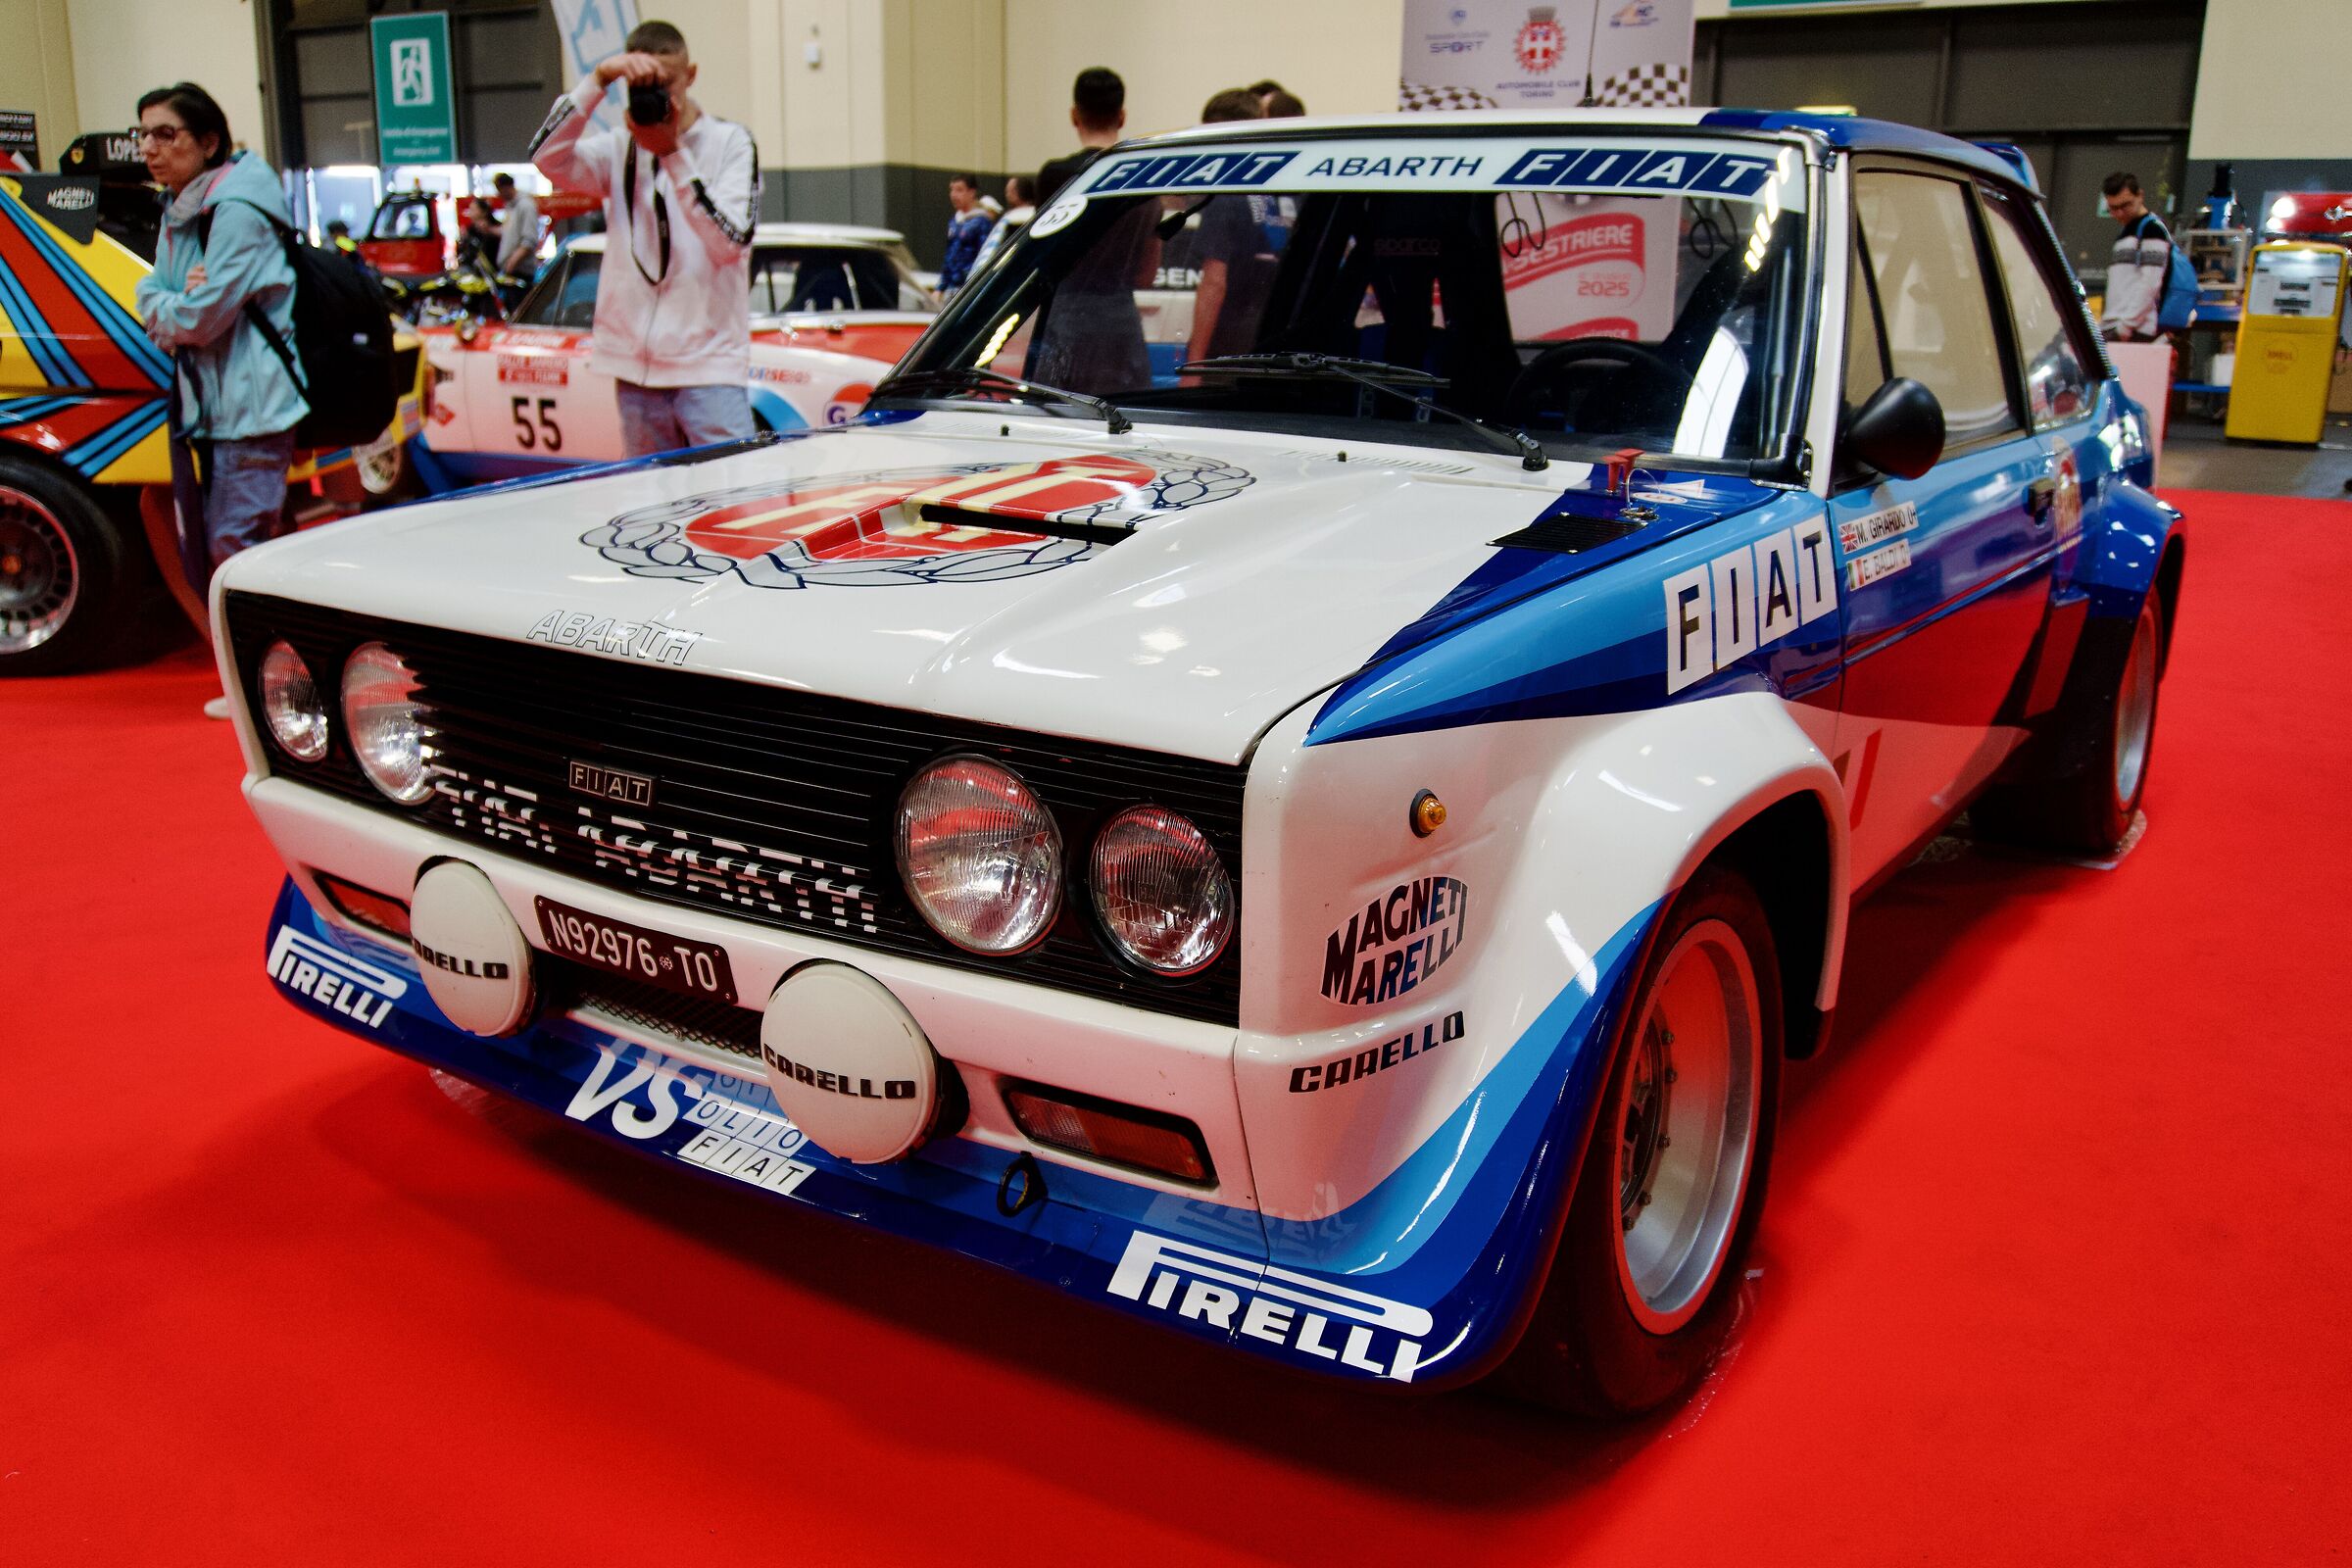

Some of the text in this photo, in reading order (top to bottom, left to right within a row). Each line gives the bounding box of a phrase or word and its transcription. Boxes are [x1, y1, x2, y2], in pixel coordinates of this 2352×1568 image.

[1495, 79, 1581, 89] AUTOMOBILE CLUB
[1094, 152, 1770, 191] FIAT ABARTH FIAT
[47, 192, 95, 211] MARELLI
[1578, 280, 1631, 298] 2025
[512, 396, 563, 452] 55
[1869, 510, 1906, 539] GIRARDO
[1874, 546, 1898, 575] BALDI
[1675, 527, 1829, 674] FIAT
[525, 609, 704, 666] ABARTH
[572, 764, 650, 803] FIAT
[577, 806, 879, 934] ABARTH
[413, 937, 509, 981] ARELLO
[549, 909, 718, 992] N92976 TO
[1321, 876, 1468, 1002] MAGNETI
[1321, 912, 1468, 1005] MARELLI
[267, 924, 408, 1029] PIRELLI
[763, 1043, 916, 1100] CARELLO
[1289, 1010, 1465, 1094] CARELLO
[564, 1043, 703, 1141] VS
[690, 1096, 808, 1153] OLIO
[686, 1132, 808, 1191] FIAT
[1106, 1230, 1434, 1384] PIRELLI
